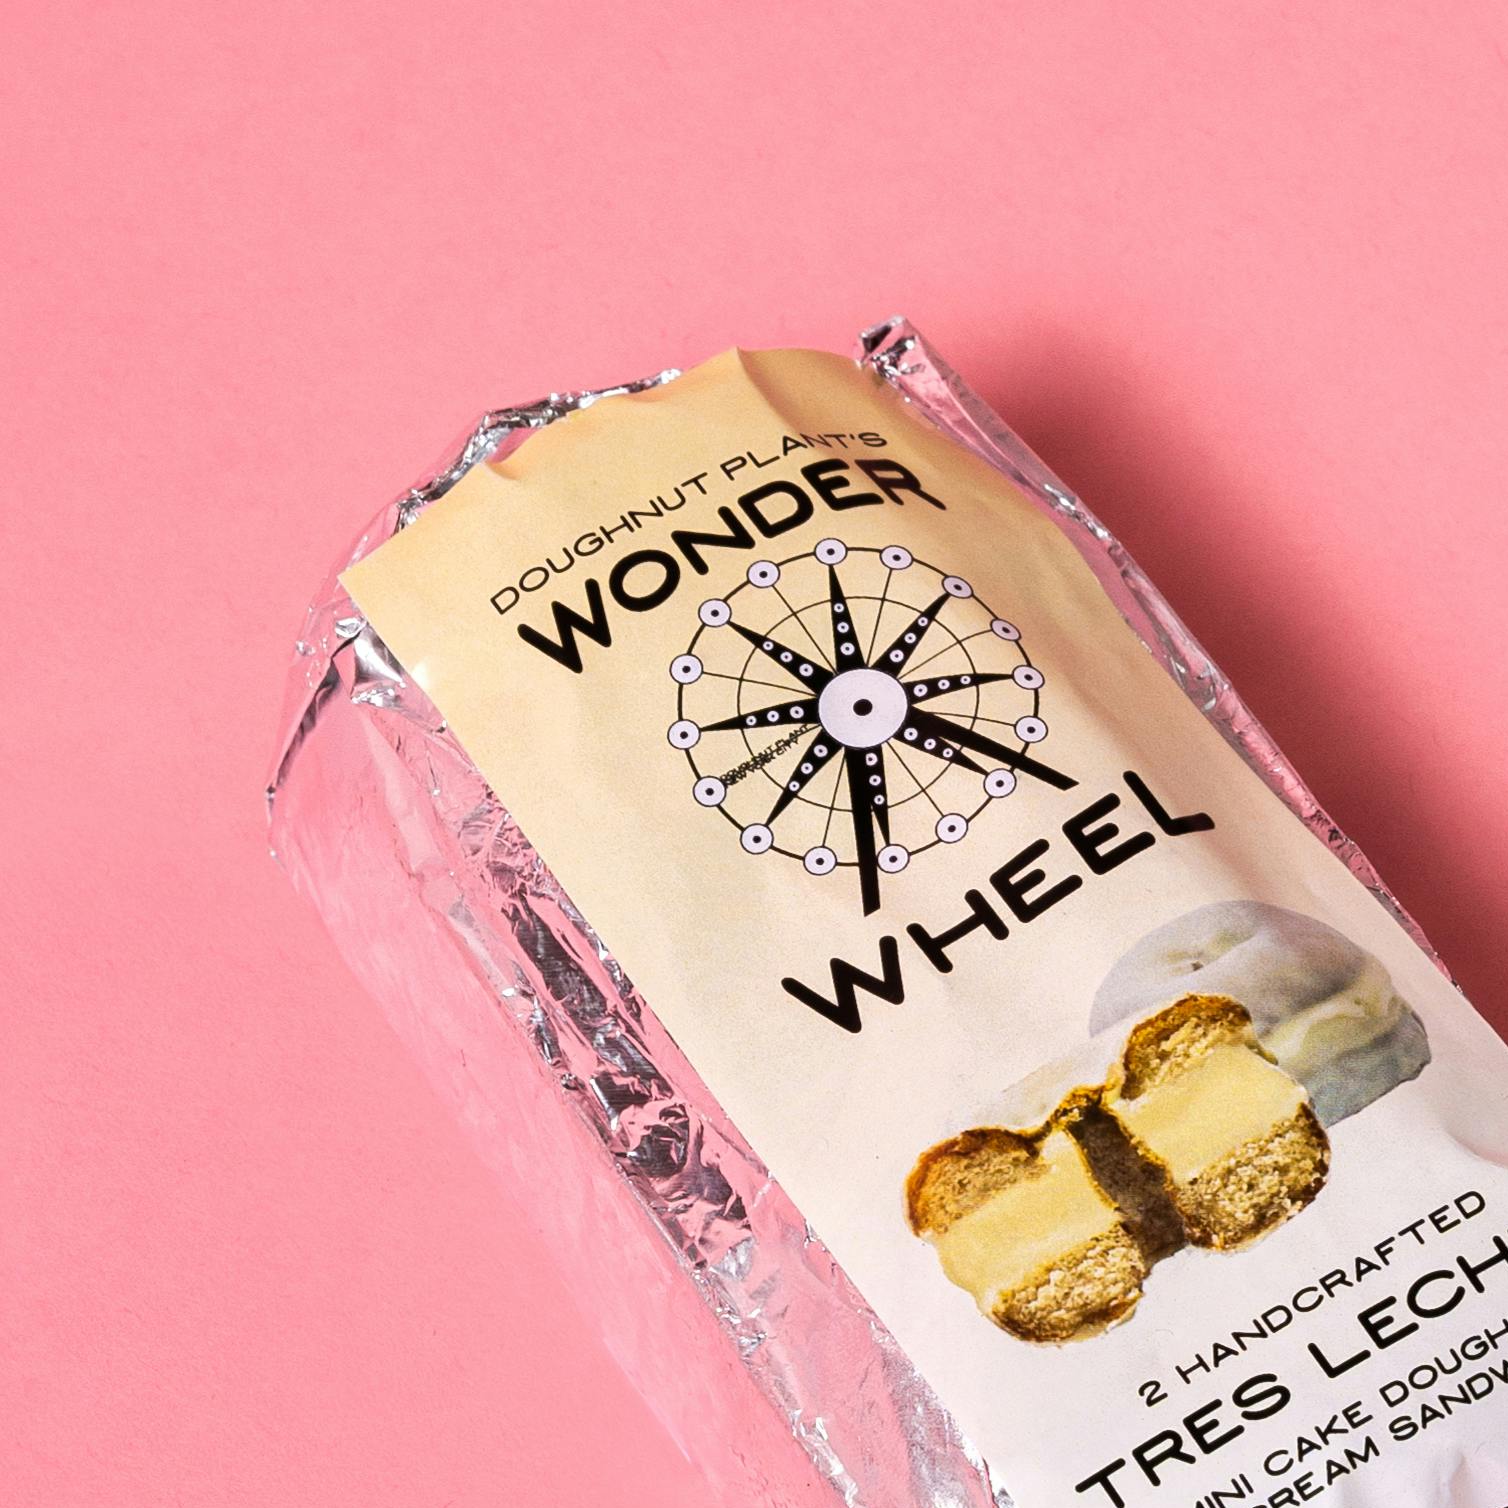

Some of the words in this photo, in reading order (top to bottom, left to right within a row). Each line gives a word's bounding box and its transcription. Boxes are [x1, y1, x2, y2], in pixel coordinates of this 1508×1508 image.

[490, 472, 708, 615] DOUGHNUT
[719, 432, 888, 481] PLANT'S
[517, 457, 947, 673] WONDER
[781, 770, 1215, 1034] WHEEL
[1138, 1380, 1168, 1408] 2
[1175, 1190, 1486, 1385] HANDCRAFTED
[1263, 1400, 1374, 1477] CAKE
